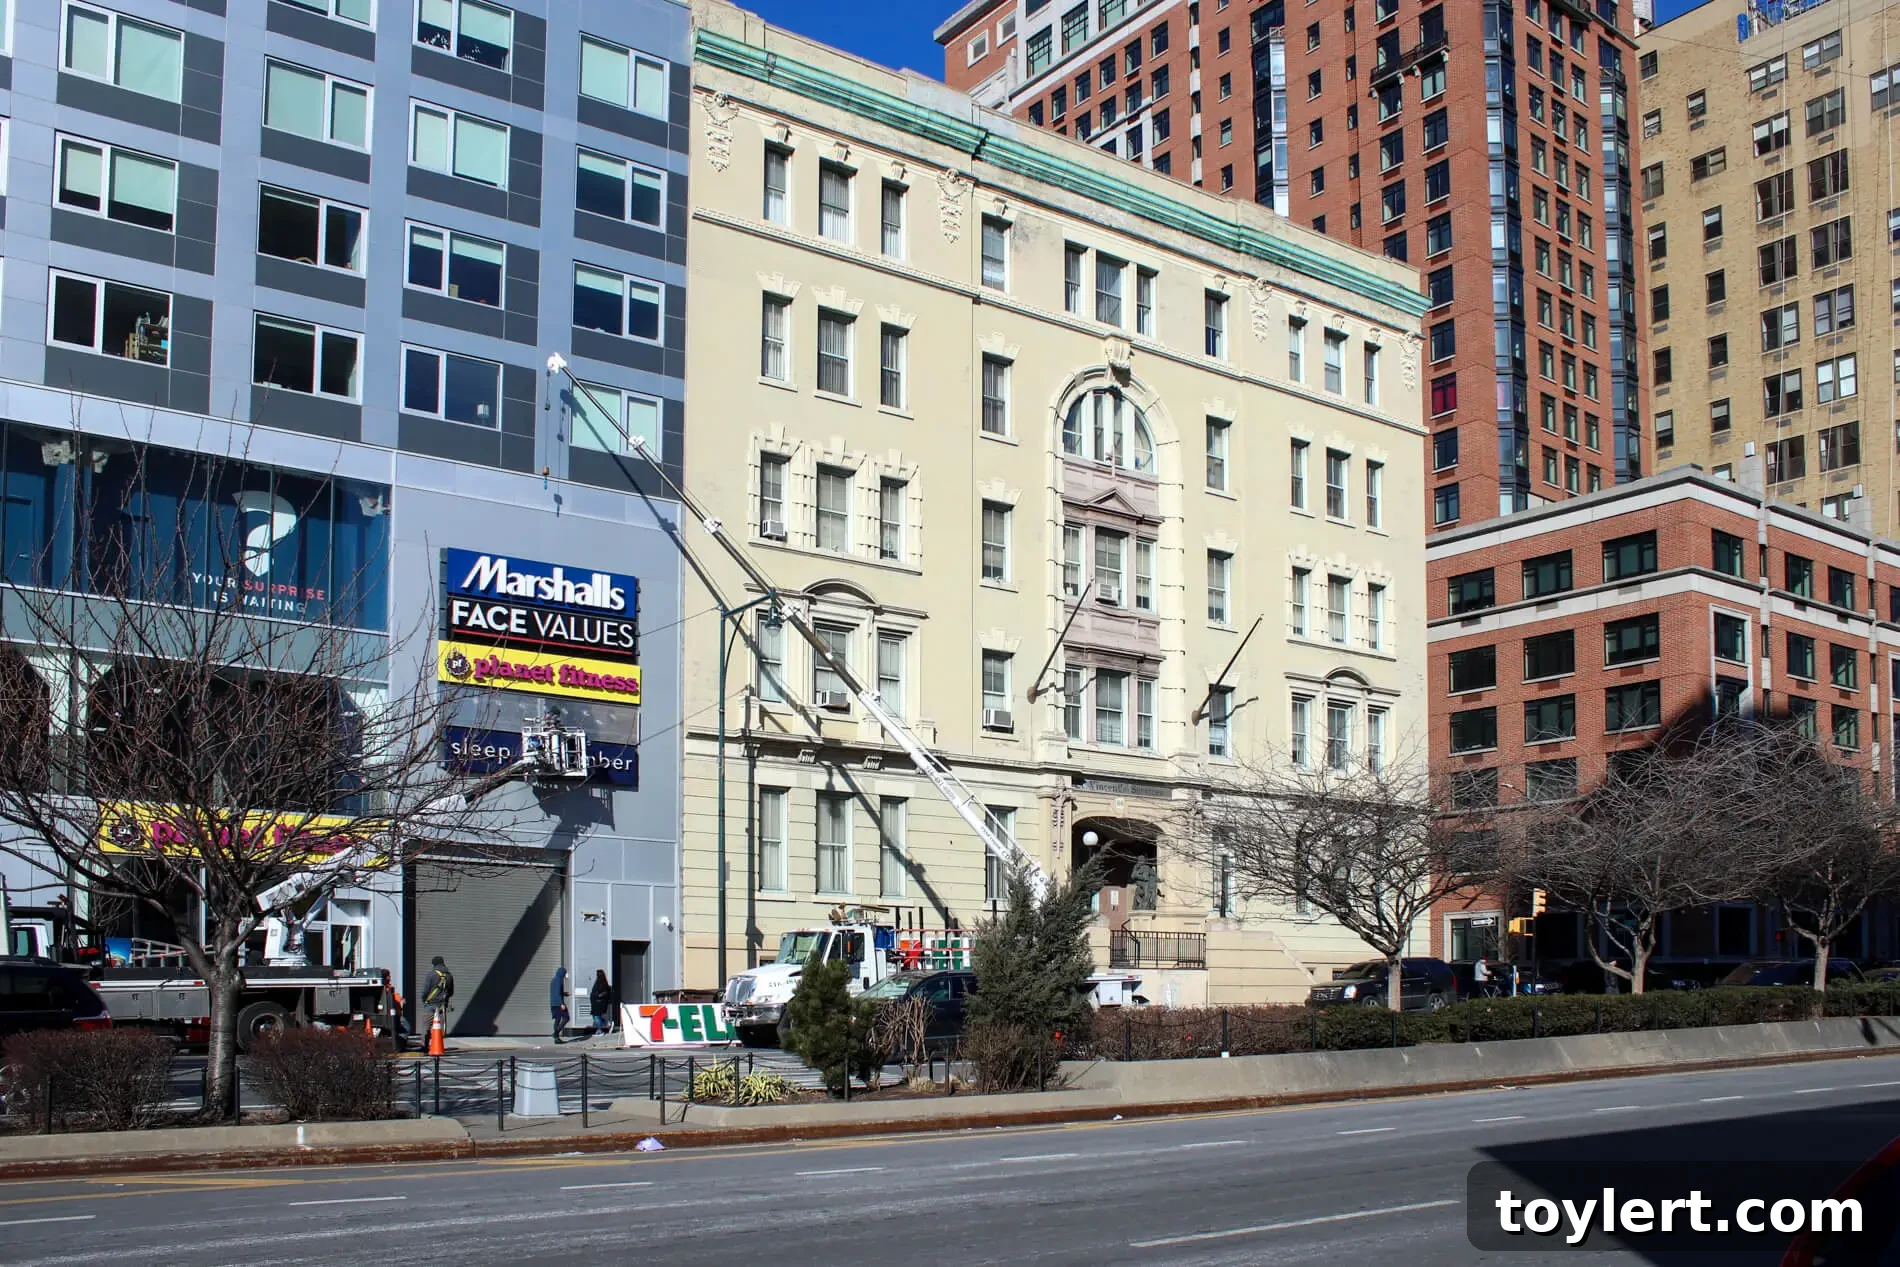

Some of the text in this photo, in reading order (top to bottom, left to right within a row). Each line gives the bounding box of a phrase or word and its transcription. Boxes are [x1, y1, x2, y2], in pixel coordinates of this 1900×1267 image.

[213, 591, 229, 602] IS
[462, 556, 625, 610] Marshalls
[452, 600, 634, 648] FACE VALUES
[474, 655, 553, 681] planet
[559, 664, 638, 692] fitness
[451, 738, 511, 764] sleep
